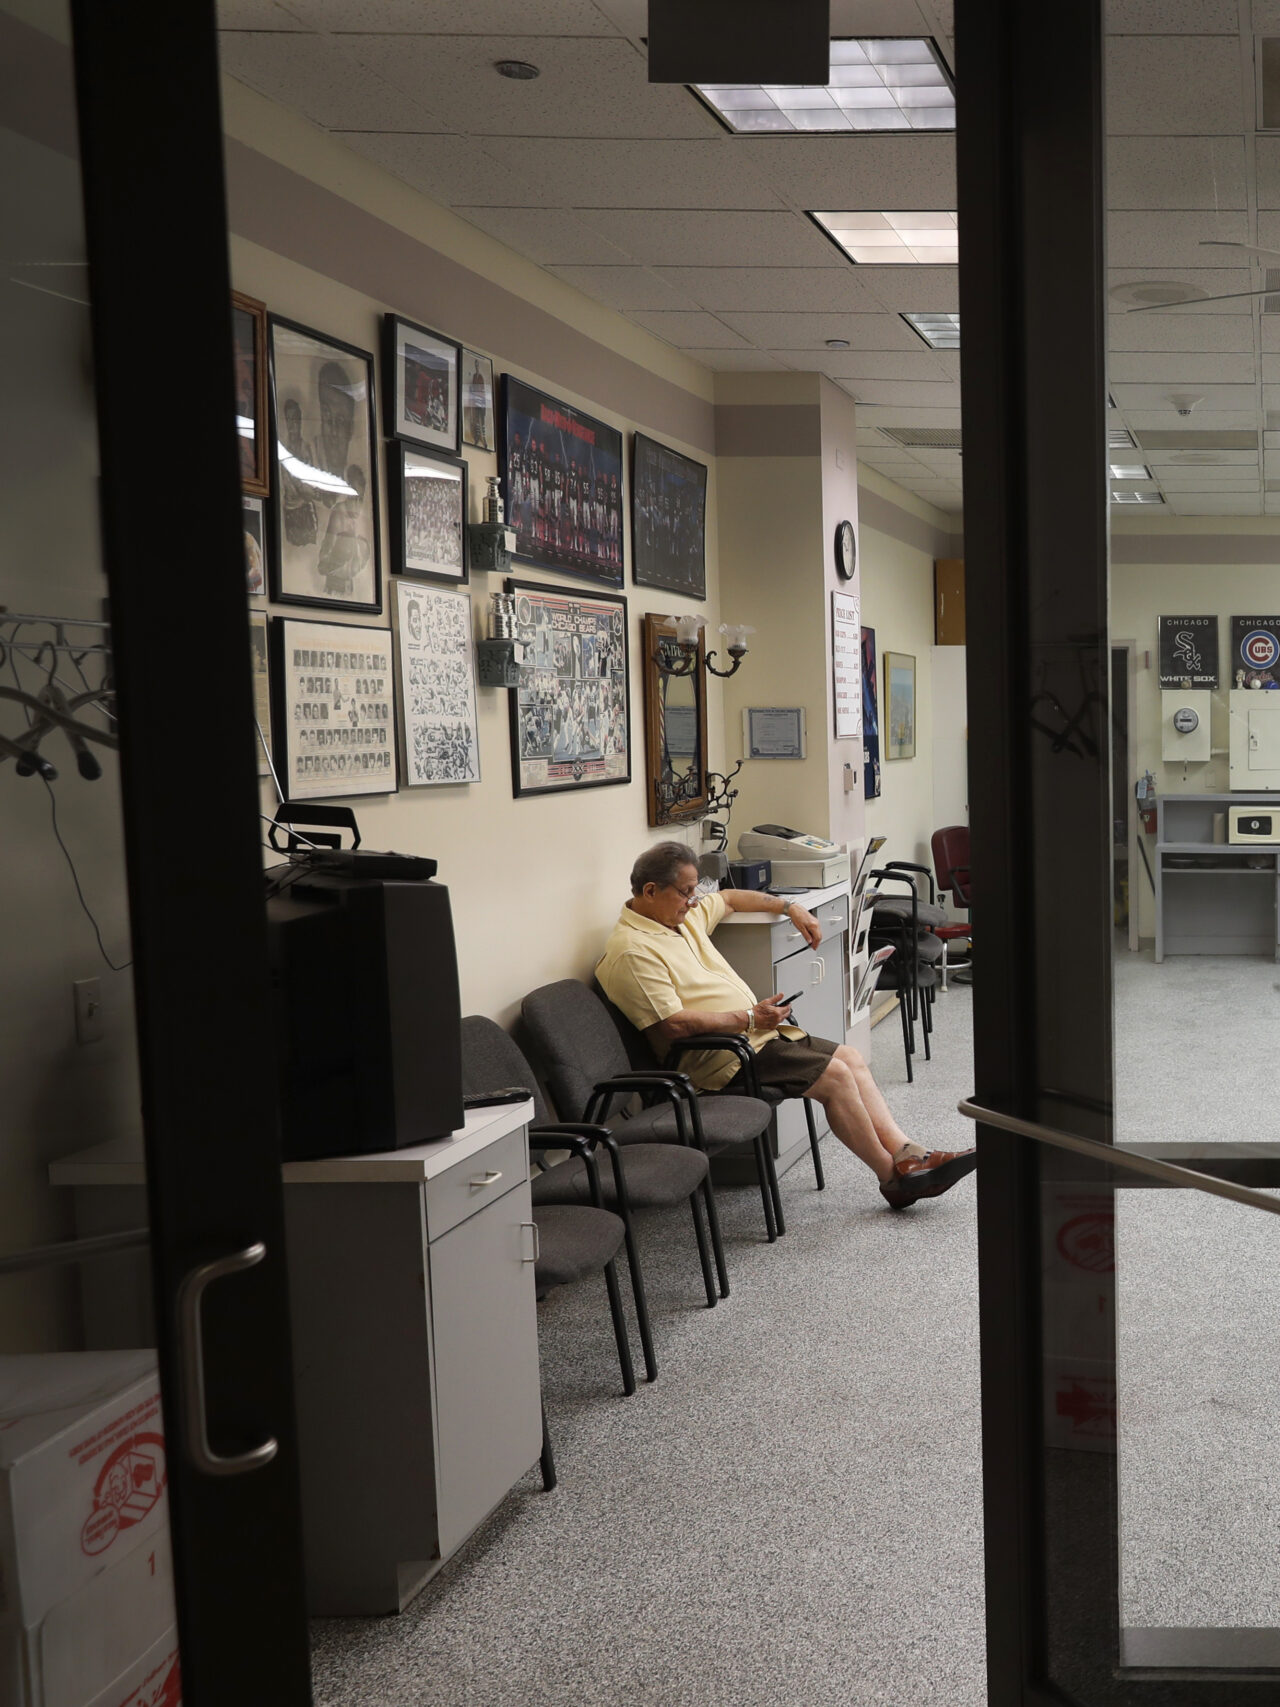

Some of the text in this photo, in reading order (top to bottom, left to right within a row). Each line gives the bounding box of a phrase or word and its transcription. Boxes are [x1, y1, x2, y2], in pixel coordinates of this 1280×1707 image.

[551, 612, 572, 623] WORLD
[552, 621, 597, 633] CHICAGO BEARS
[1247, 637, 1274, 662] CUBS
[147, 1551, 156, 1576] 1
